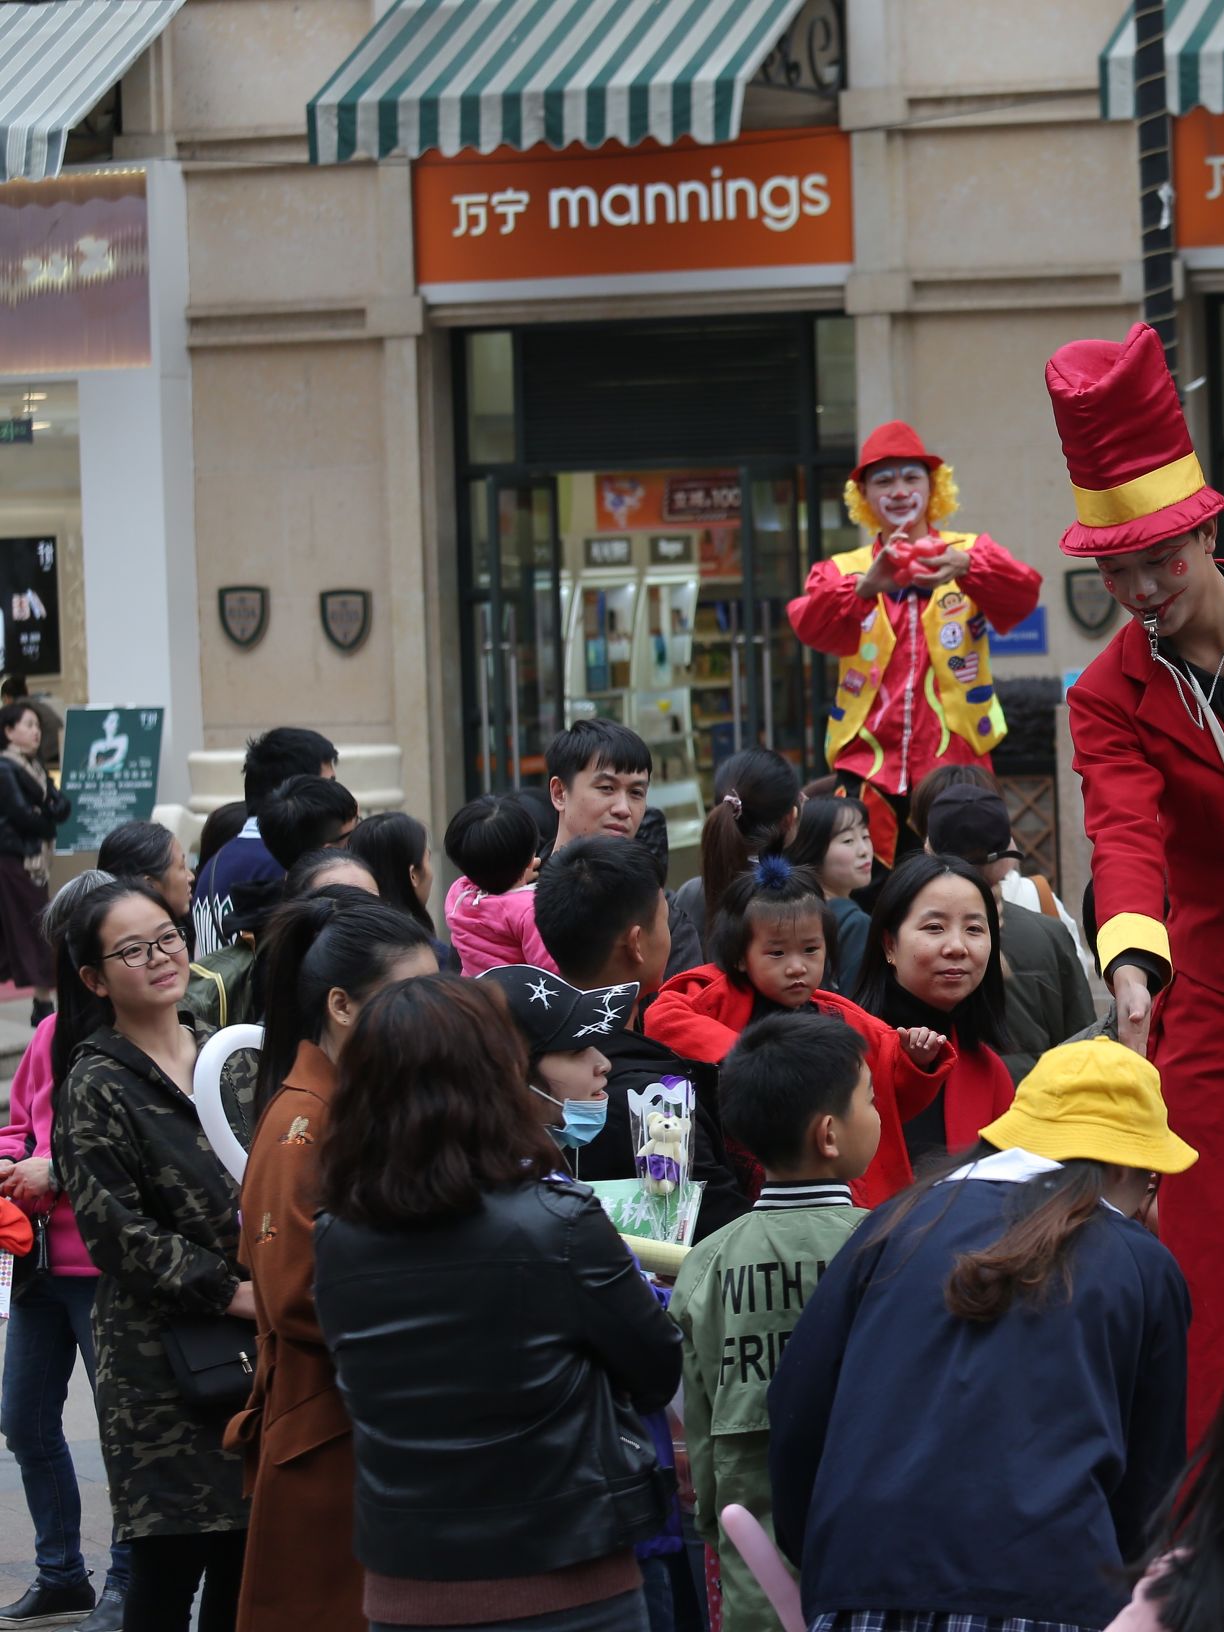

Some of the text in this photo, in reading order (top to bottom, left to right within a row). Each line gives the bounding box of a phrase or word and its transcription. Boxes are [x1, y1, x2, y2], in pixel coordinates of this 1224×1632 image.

[451, 166, 832, 238] 万宁 mannings
[717, 1261, 804, 1314] WITH
